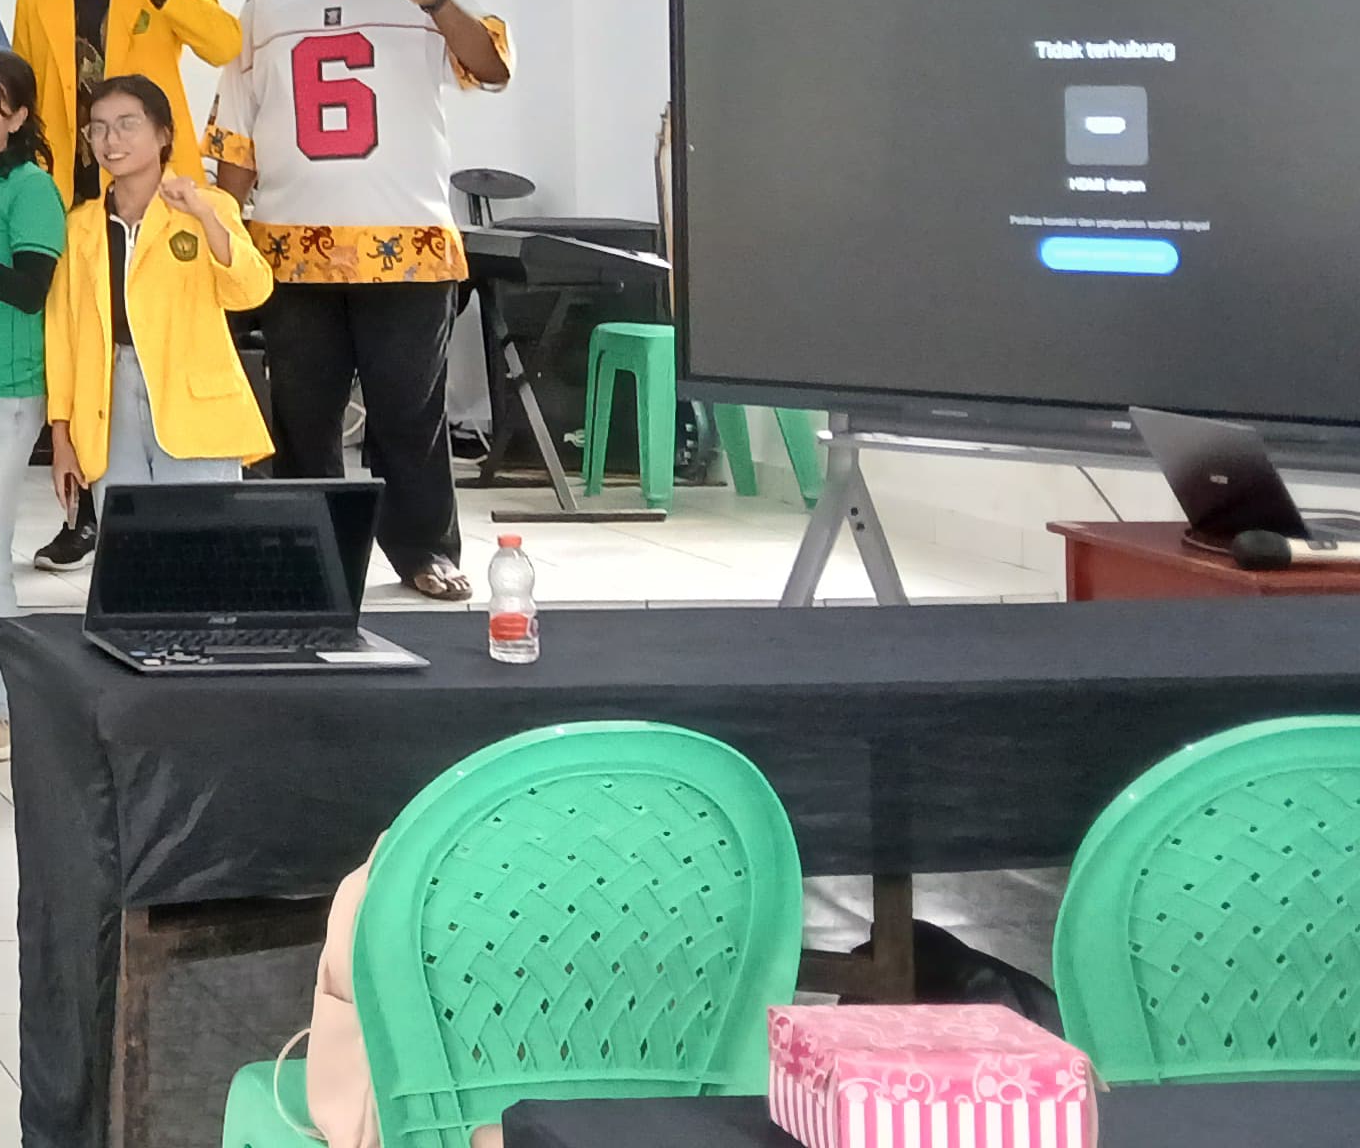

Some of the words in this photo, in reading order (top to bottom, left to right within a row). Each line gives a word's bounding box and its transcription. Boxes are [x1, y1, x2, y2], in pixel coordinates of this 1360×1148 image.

[1034, 39, 1085, 60] Tidak
[1086, 38, 1177, 62] terhubung
[291, 31, 379, 161] 6
